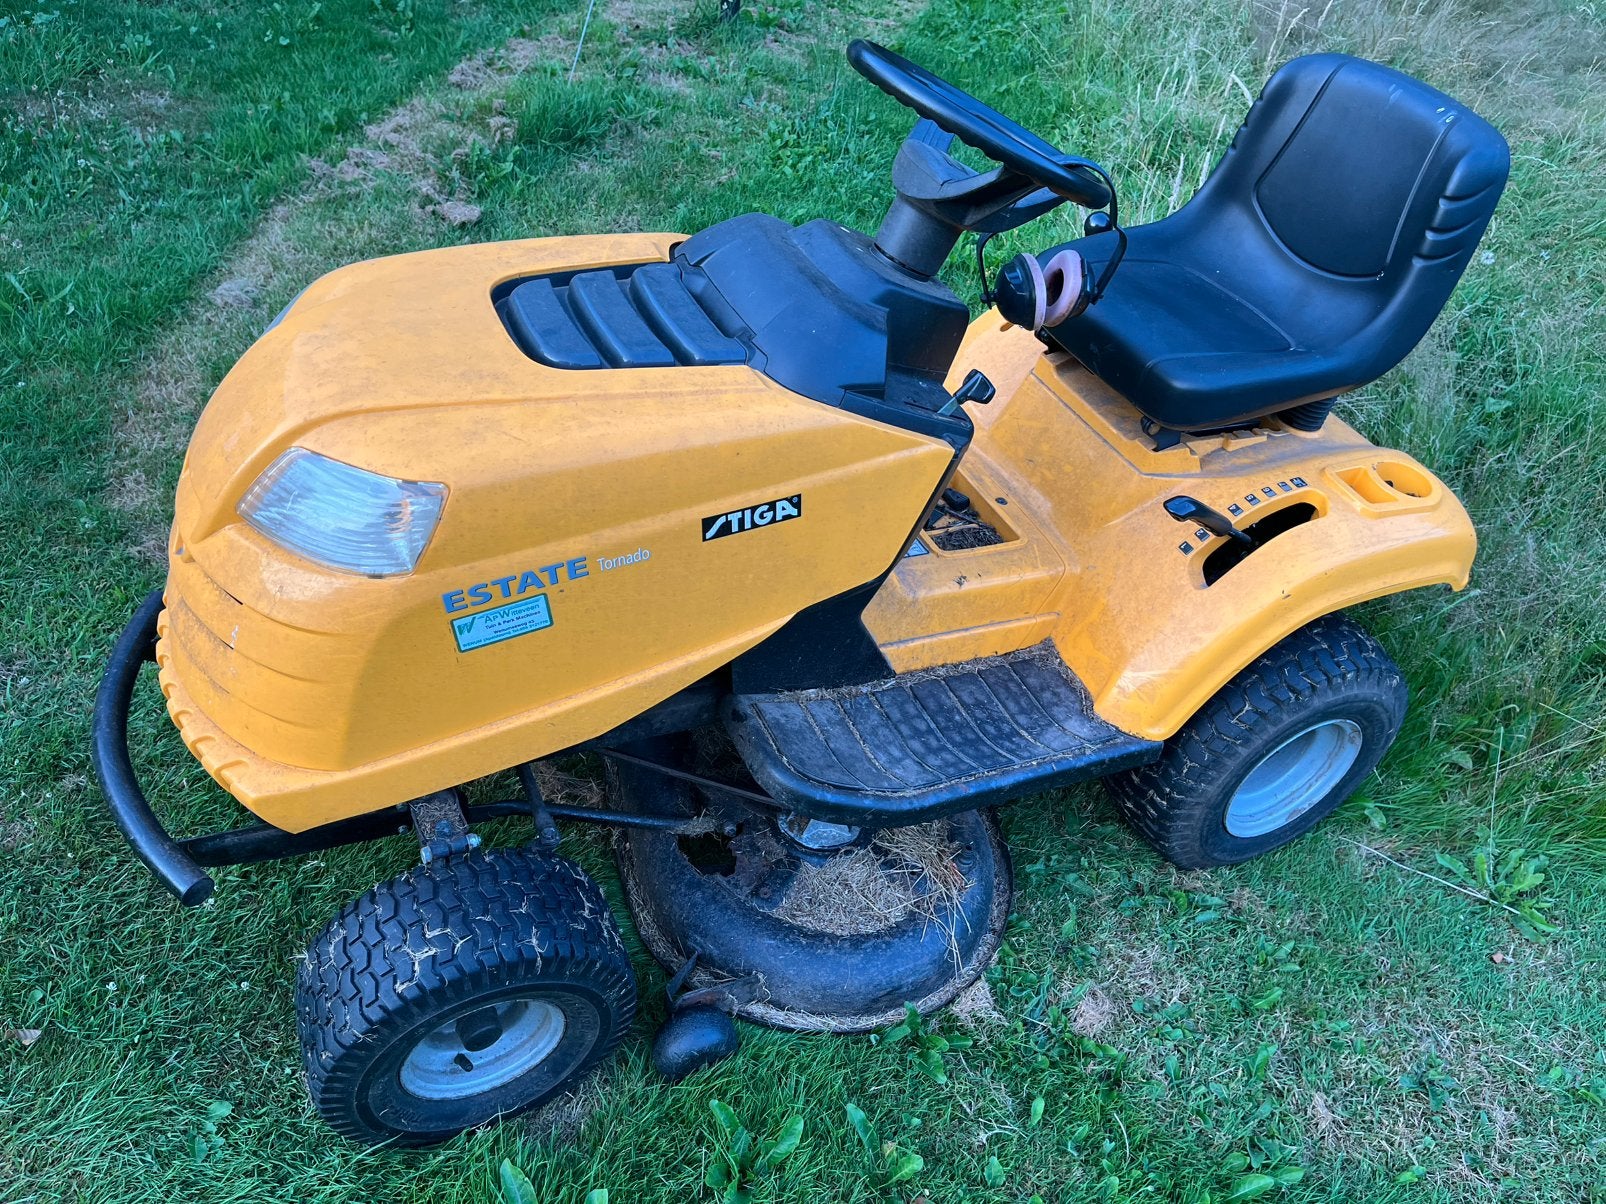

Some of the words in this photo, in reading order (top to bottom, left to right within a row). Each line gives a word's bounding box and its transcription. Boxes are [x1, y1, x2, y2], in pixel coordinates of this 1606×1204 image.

[705, 498, 798, 540] STIGA
[441, 556, 590, 614] ESTATE
[596, 547, 651, 572] Tornado
